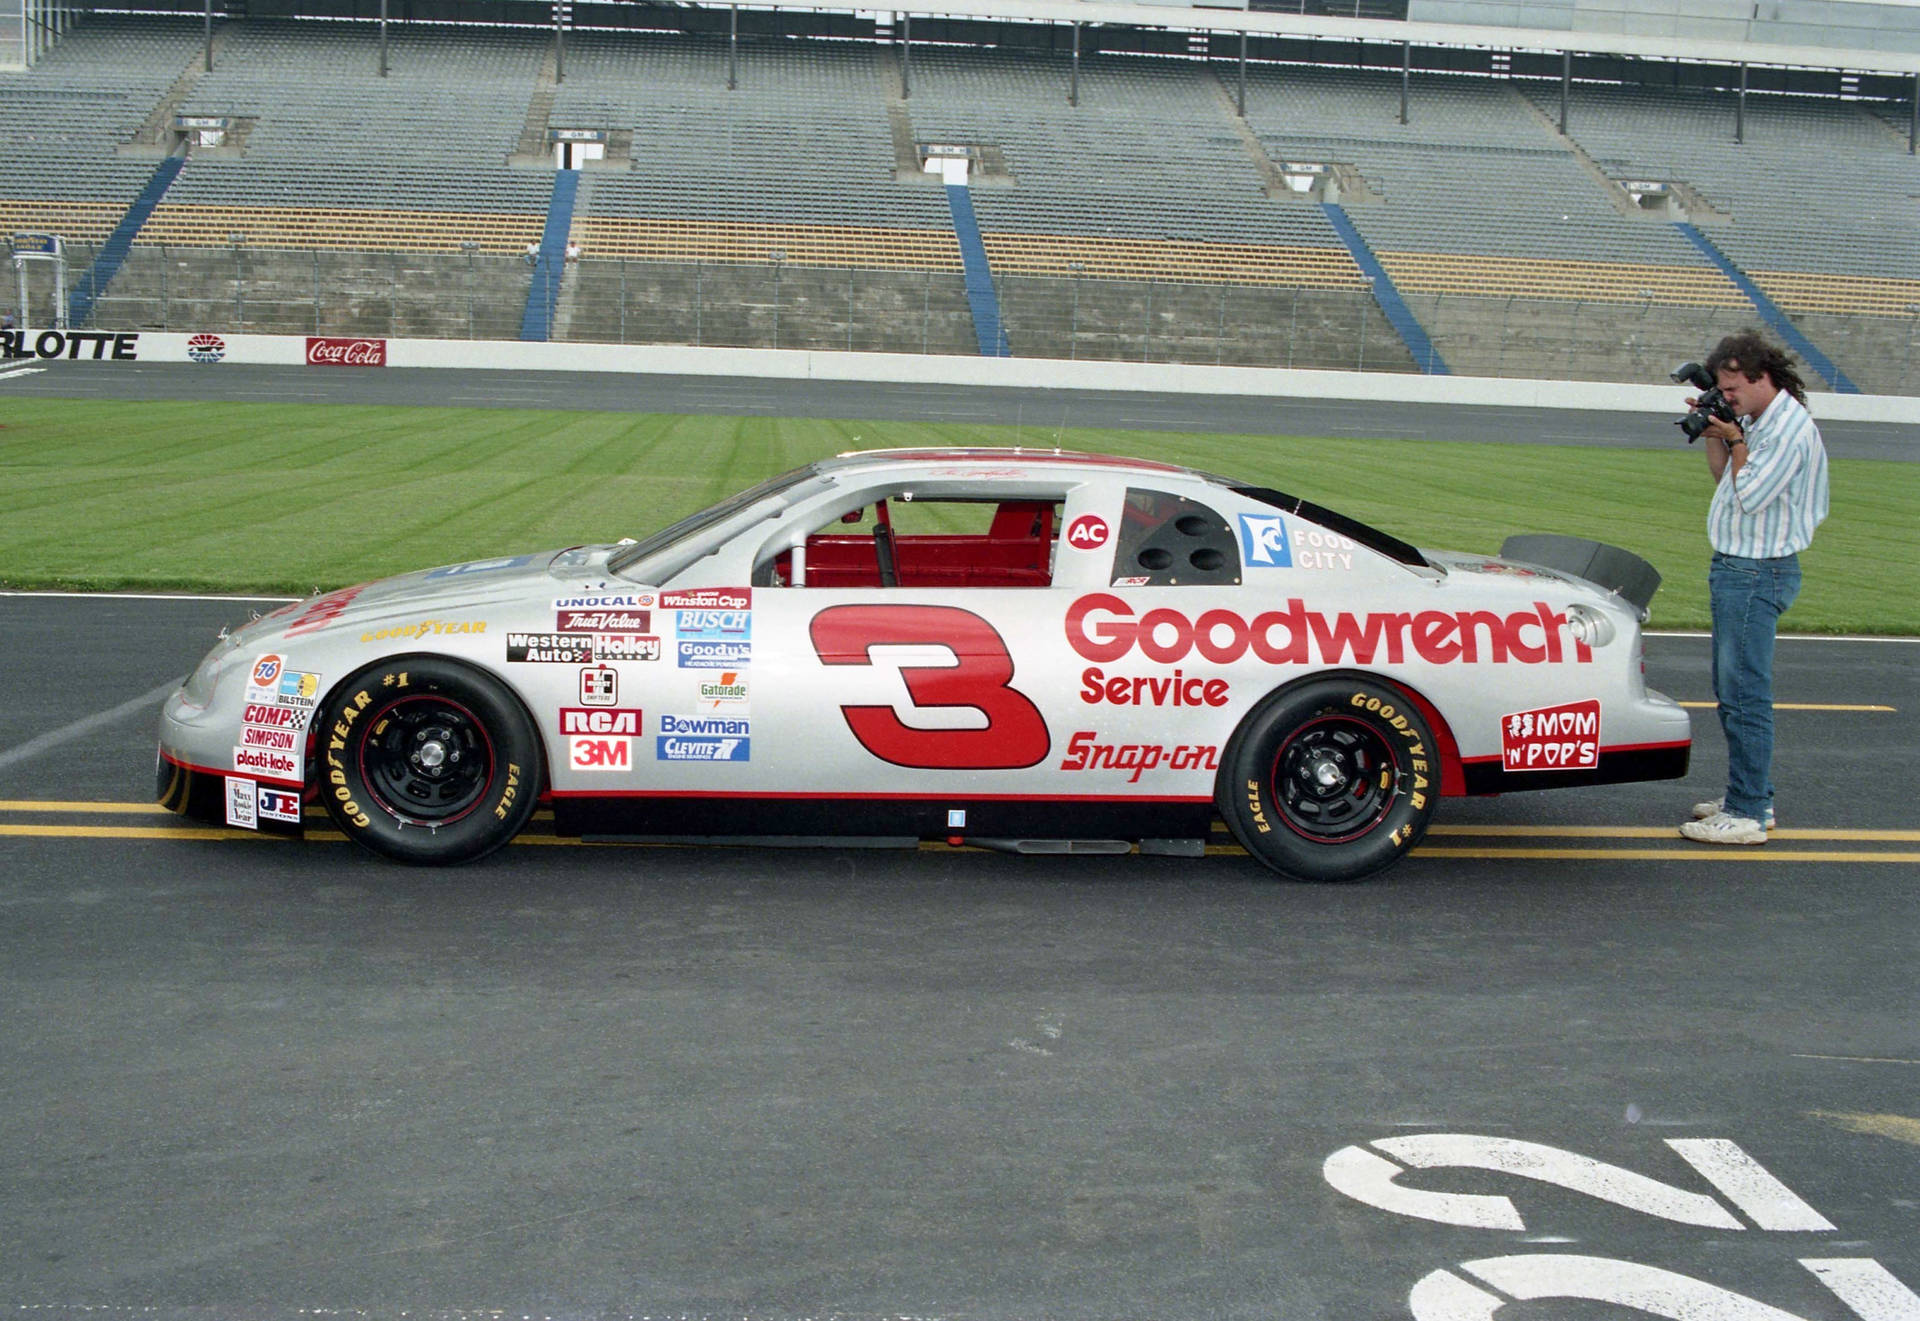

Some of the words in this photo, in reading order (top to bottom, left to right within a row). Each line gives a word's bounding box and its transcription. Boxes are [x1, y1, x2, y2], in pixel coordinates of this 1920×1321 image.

[309, 340, 381, 364] Coca-Cola
[1070, 523, 1106, 543] AC
[1294, 529, 1355, 551] FOOD
[1299, 551, 1353, 571] CITY
[556, 596, 637, 608] UNOCAL
[664, 595, 717, 607] Winston
[718, 595, 748, 609] Cup
[360, 619, 487, 643] GOODYEAR
[565, 612, 598, 629] True
[592, 612, 641, 630] Value
[680, 611, 747, 629] BUSCH
[1065, 592, 1593, 665] Goodwrench
[508, 634, 592, 648] Western
[596, 635, 660, 660] Holley
[680, 643, 751, 658] Goody's
[526, 648, 574, 662] Auto
[258, 662, 277, 679] 76
[383, 672, 410, 688] #1
[701, 684, 746, 696] Gatorade
[808, 603, 1052, 771] 3
[1081, 666, 1230, 707] Service
[279, 695, 314, 707] BILSTEIN
[244, 705, 292, 726] COMP
[565, 711, 637, 733] RCA
[661, 715, 750, 734] Bowman
[1537, 712, 1596, 736] MOM
[245, 728, 294, 749] SIMPSON
[237, 750, 295, 772] plasti-kote
[327, 690, 373, 828] GOODYEAR
[573, 740, 628, 766] 3M
[1061, 731, 1219, 783] Snap-on
[1351, 692, 1429, 810] GOODYEAR
[1527, 740, 1595, 766] POP'S
[494, 762, 521, 820] EAGLE
[260, 791, 298, 816] JE
[1247, 779, 1271, 834] EAGLE
